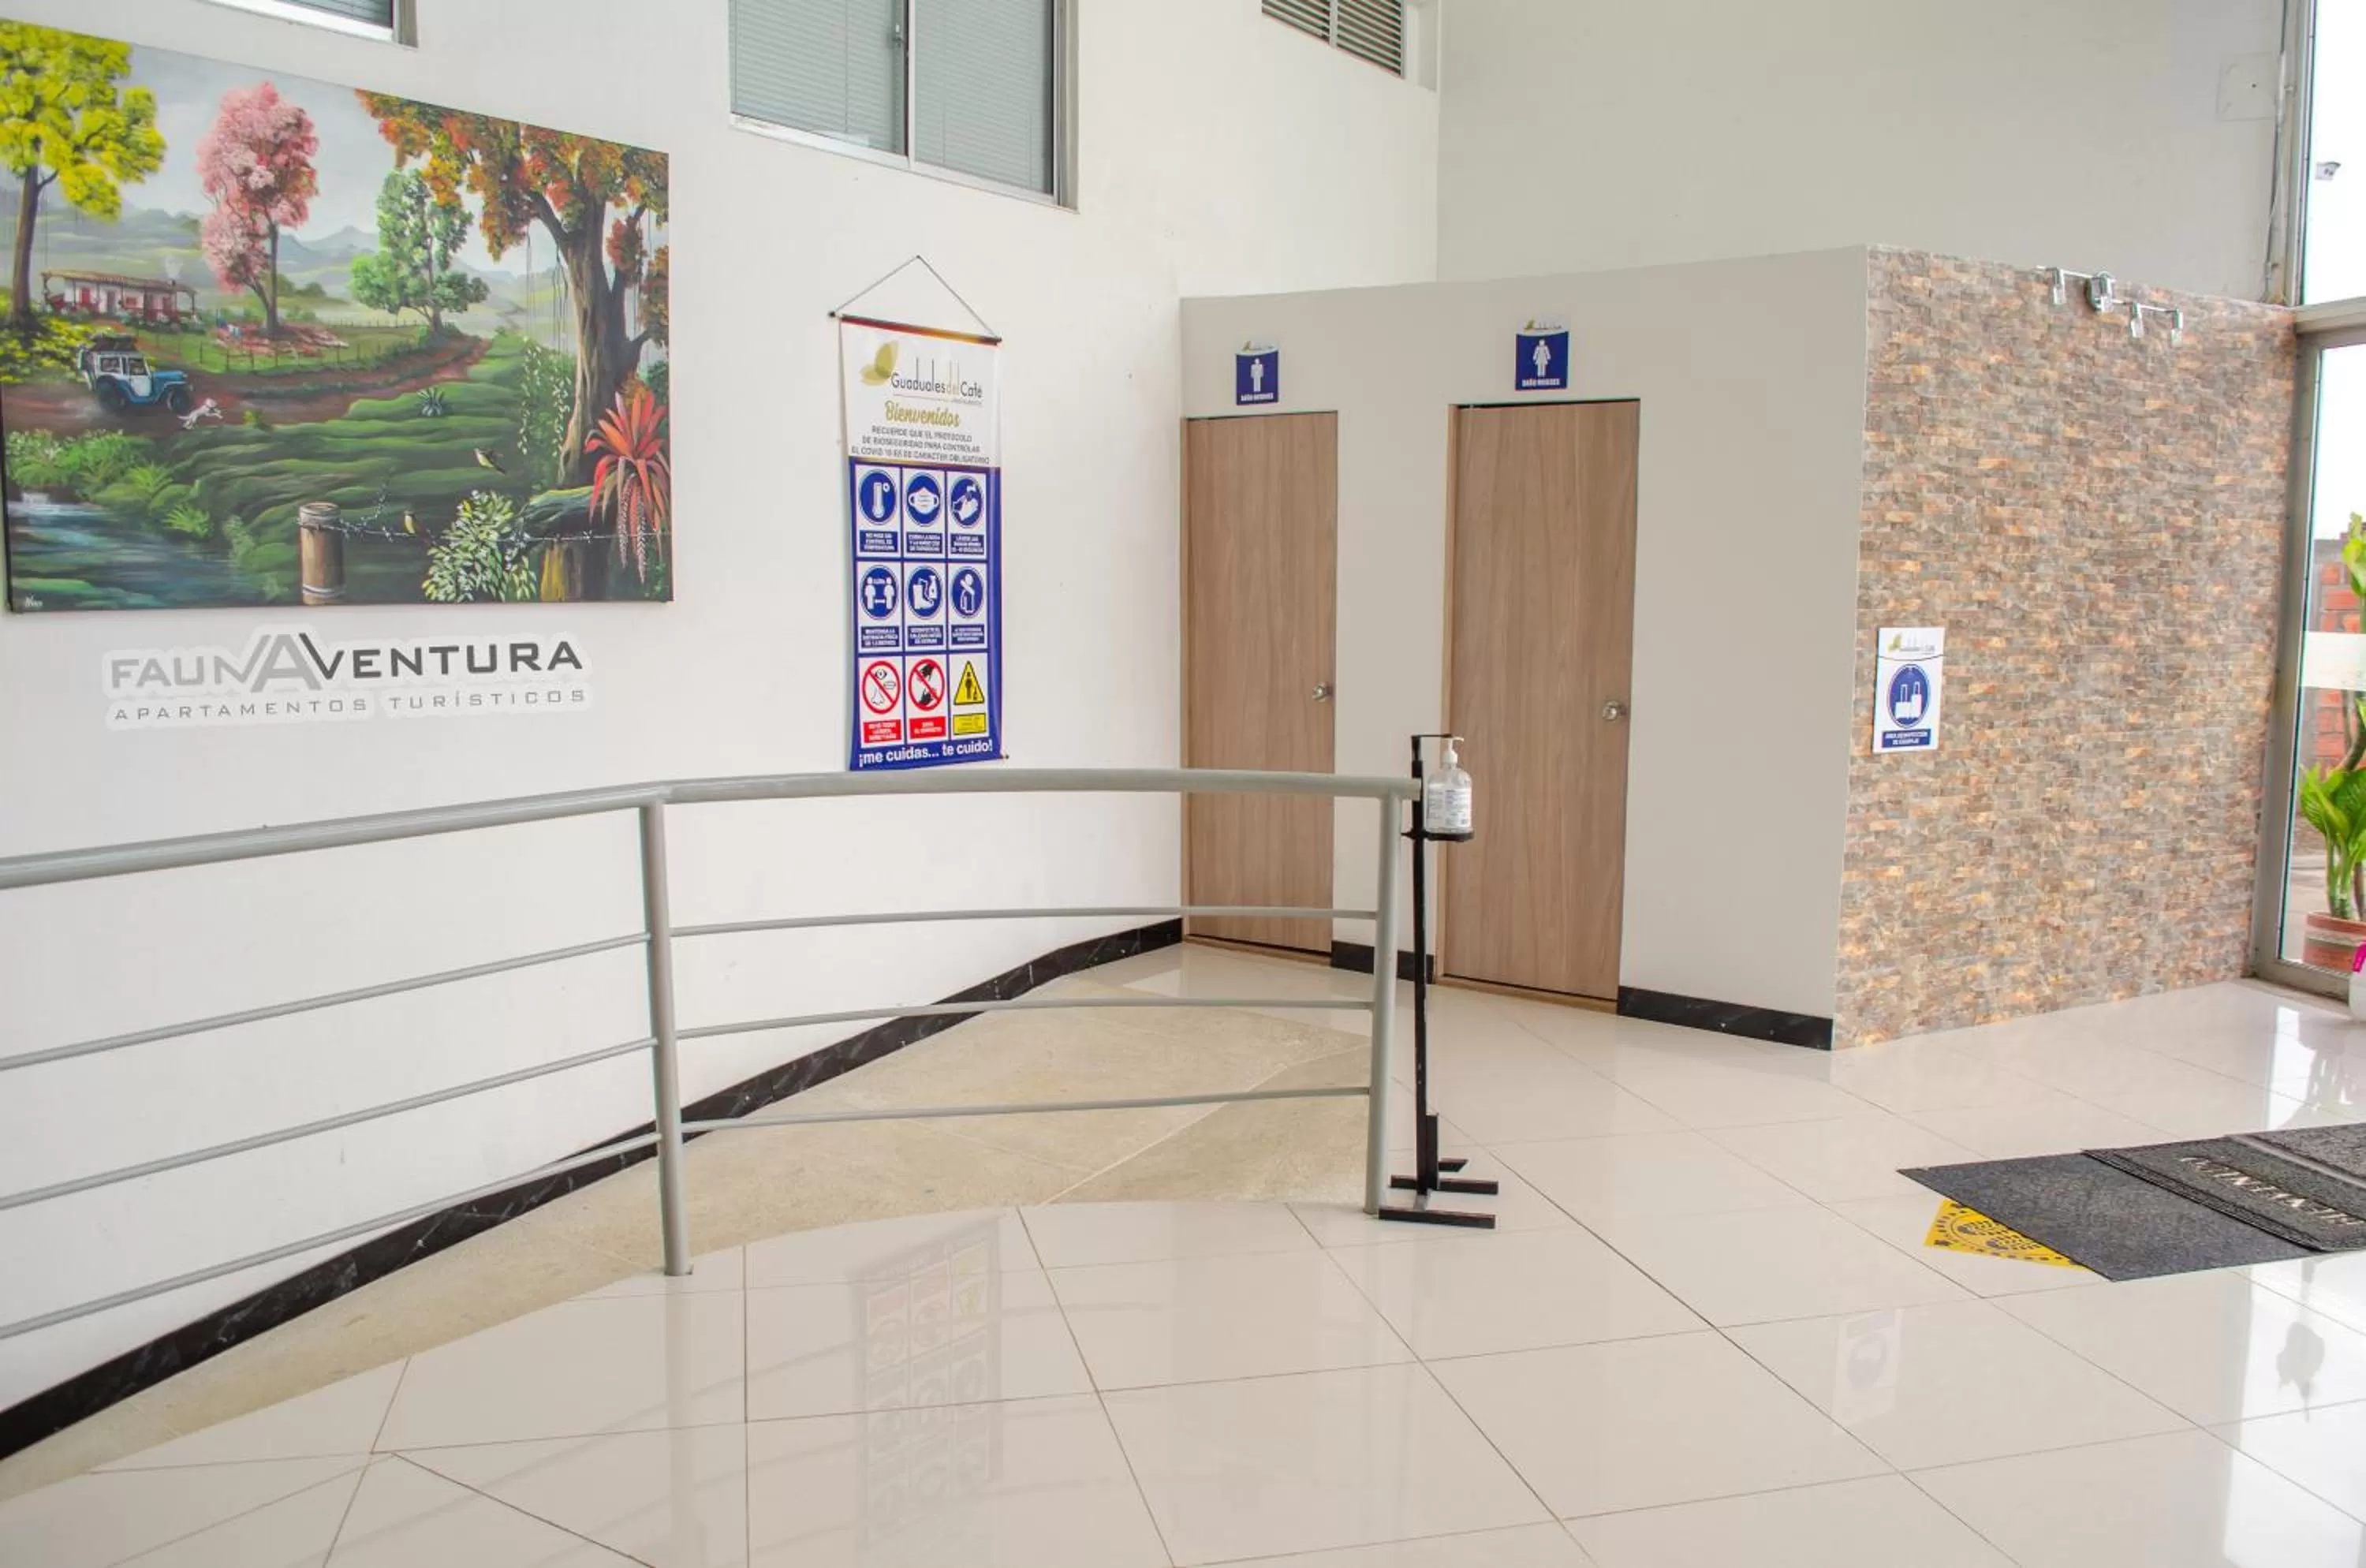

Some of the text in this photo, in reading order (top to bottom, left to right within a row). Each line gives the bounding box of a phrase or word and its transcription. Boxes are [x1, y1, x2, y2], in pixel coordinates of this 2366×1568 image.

[885, 400, 961, 428] Bienvenidos
[114, 689, 587, 721] APARTAMENTOS TURÍSTICOS
[859, 739, 993, 767] ¡me cuidas... te cuido!
